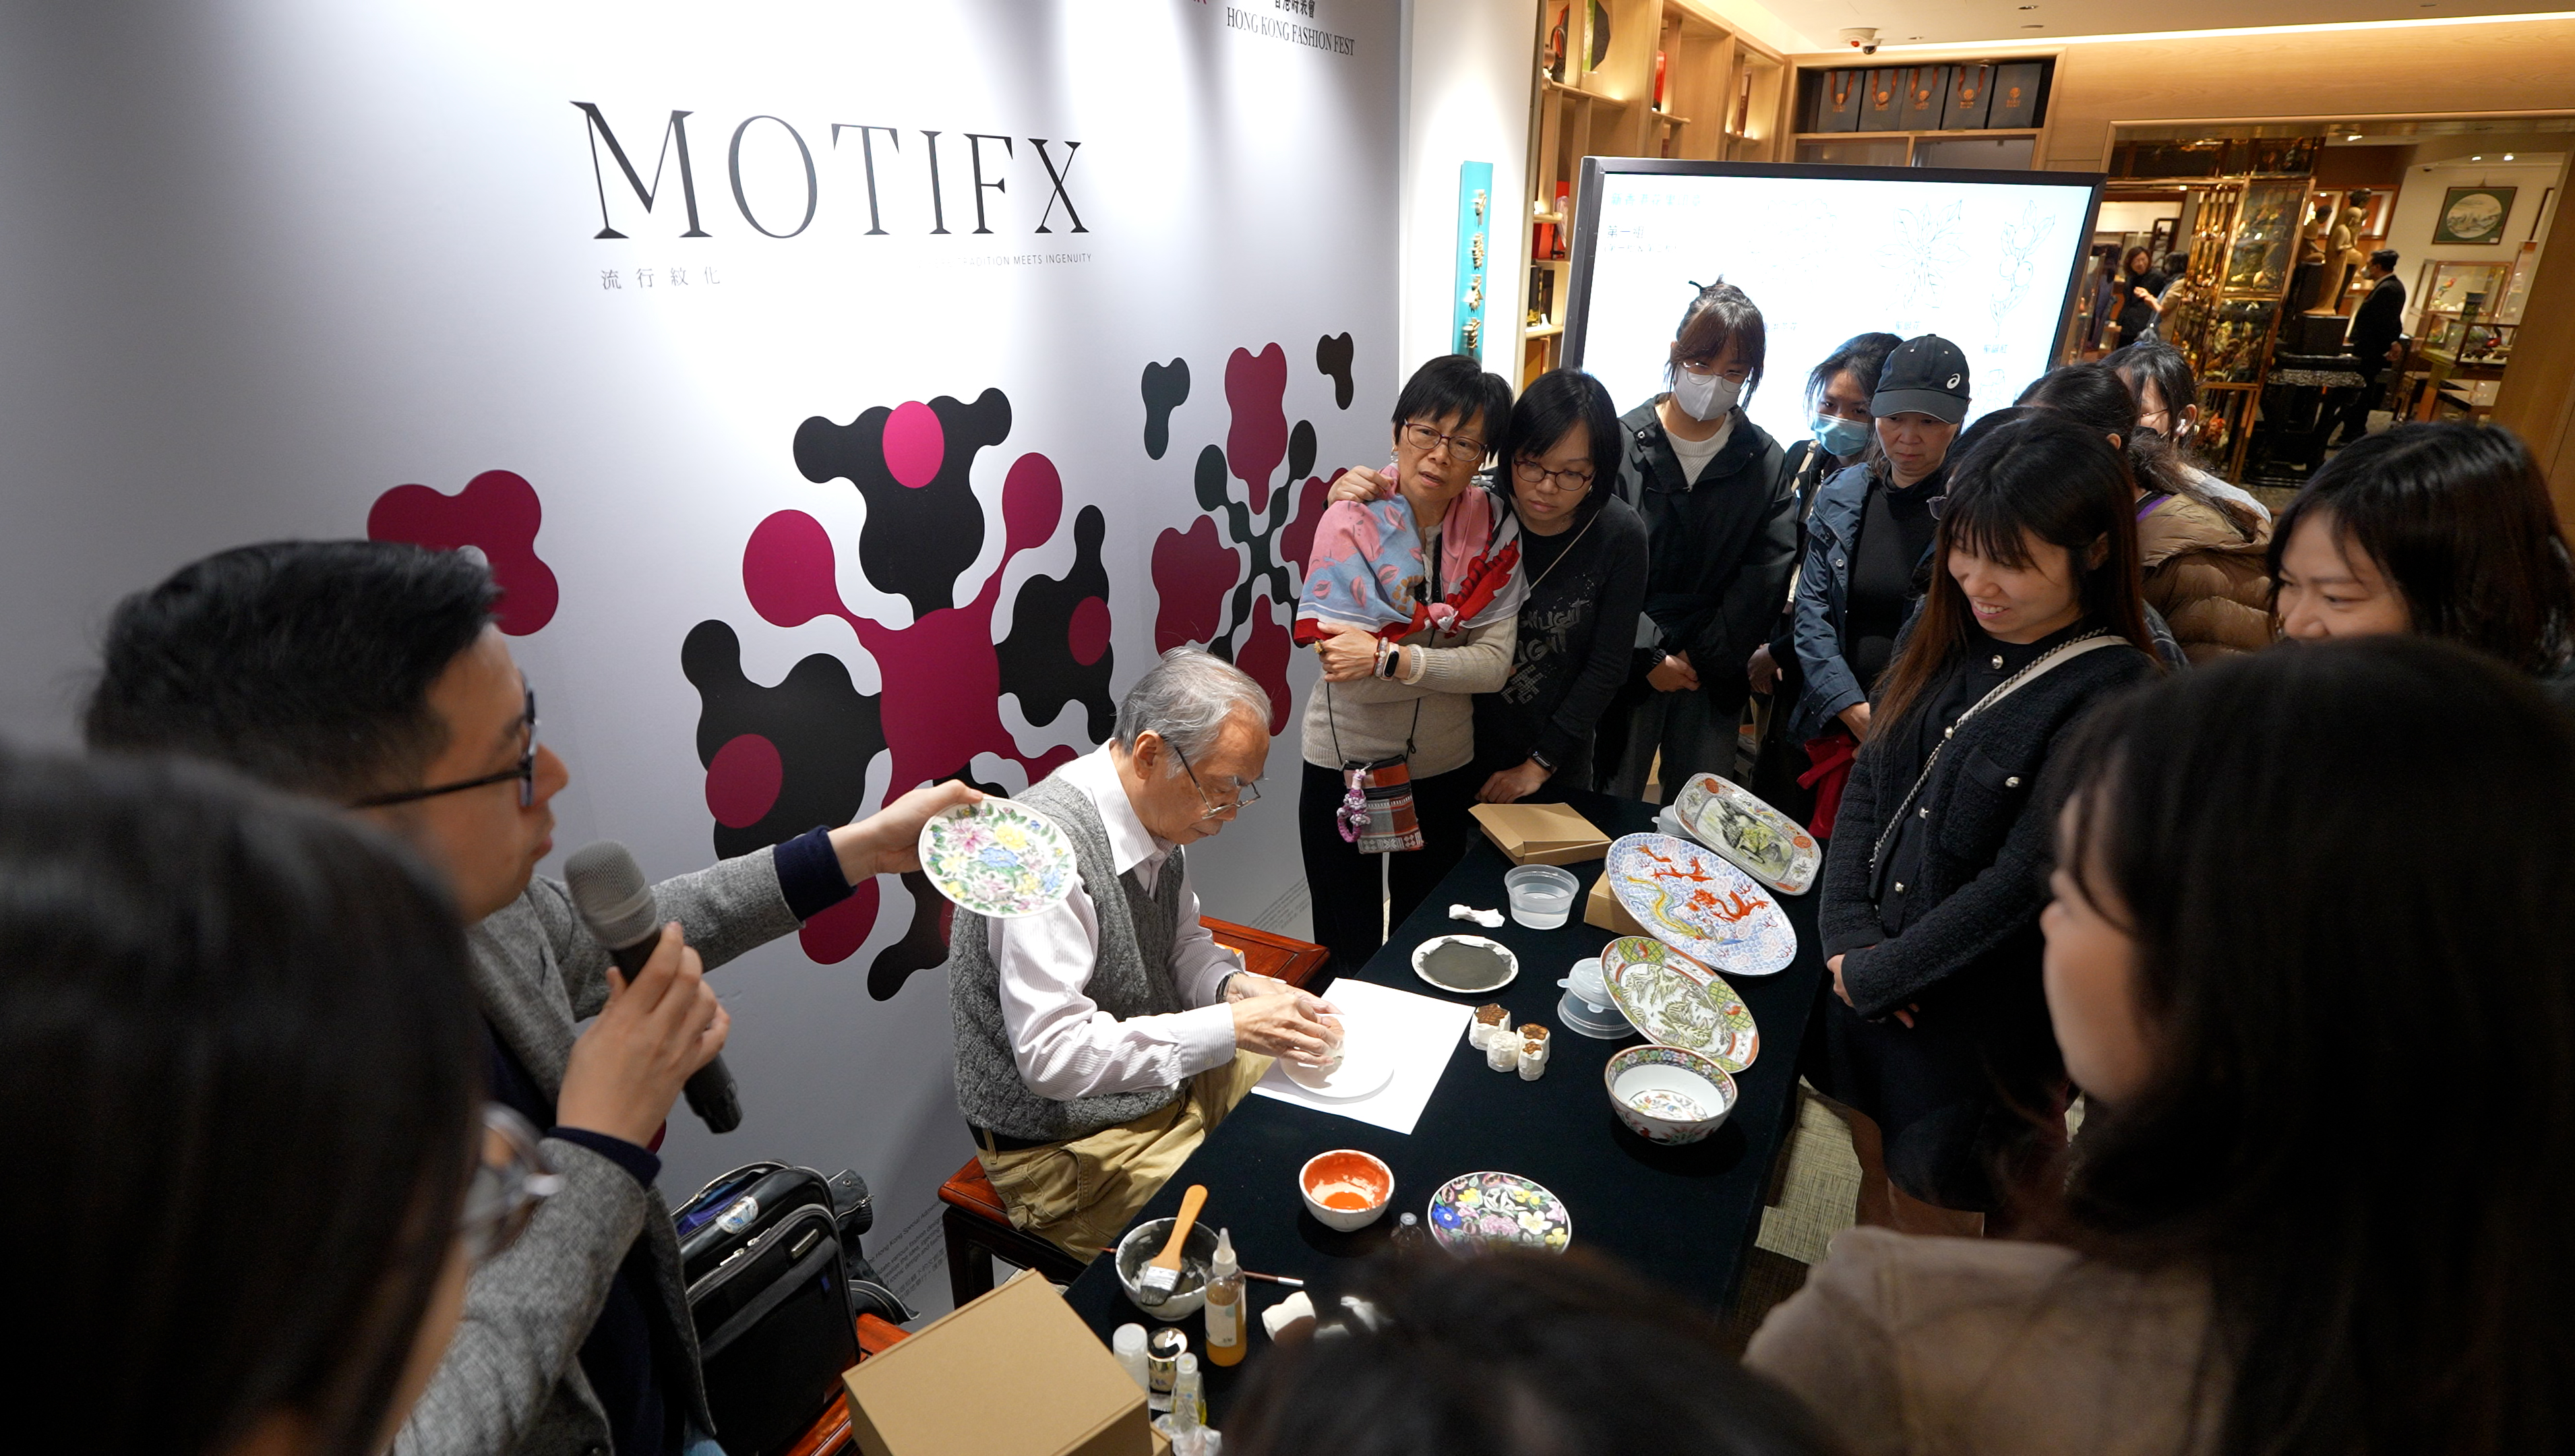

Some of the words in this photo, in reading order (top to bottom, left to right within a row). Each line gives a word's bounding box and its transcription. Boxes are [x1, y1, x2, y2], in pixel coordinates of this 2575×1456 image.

[1227, 7, 1259, 33] HONG
[1261, 16, 1290, 41] KONG
[1292, 24, 1332, 51] FASHION
[1333, 35, 1355, 56] FEST
[569, 101, 1090, 239] MOTIFX
[1013, 254, 1043, 265] MEETS
[1046, 252, 1091, 264] INGENUITY
[601, 266, 721, 290] 流行紋化
[1518, 598, 1589, 631] GHLIGHT
[889, 1233, 903, 1246] Kong
